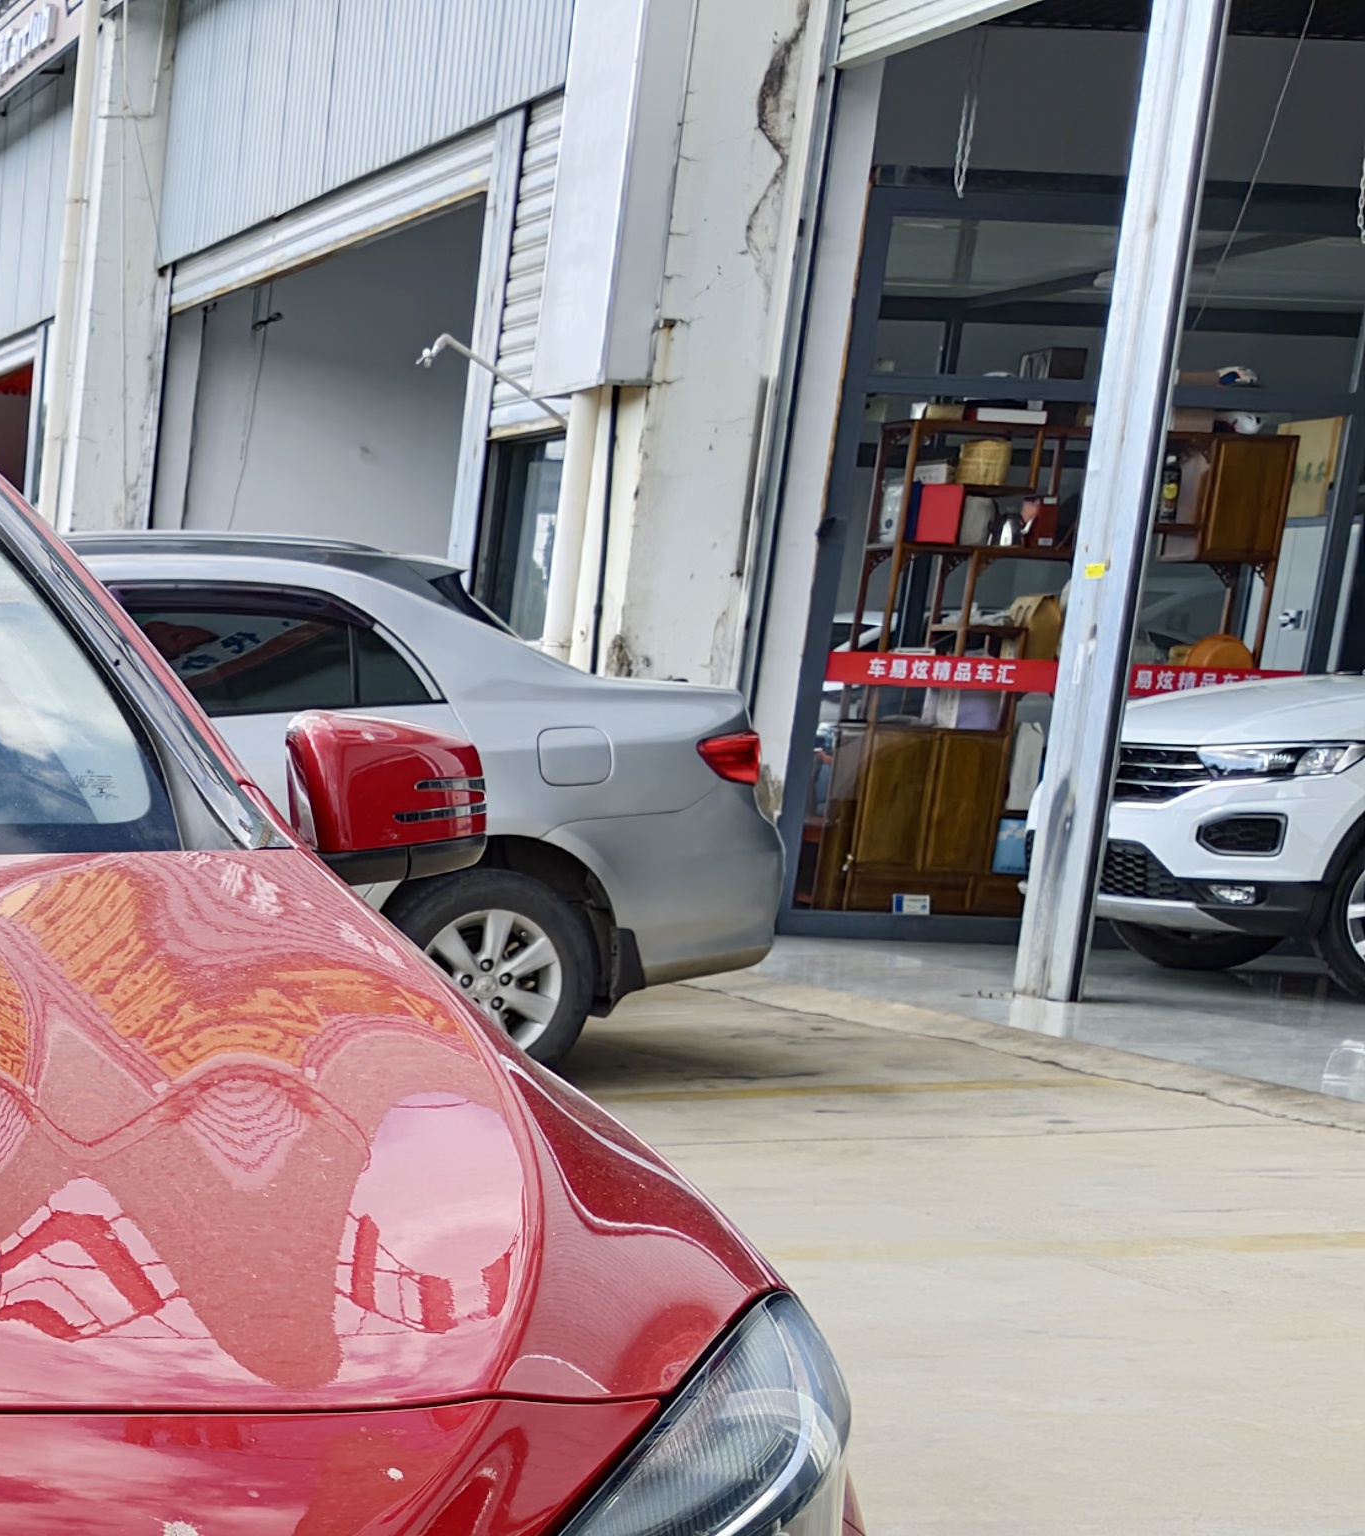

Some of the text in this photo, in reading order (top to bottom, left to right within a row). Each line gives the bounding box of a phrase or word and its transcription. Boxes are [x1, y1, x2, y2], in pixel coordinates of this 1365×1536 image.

[867, 658, 1017, 684] 车易炫精品车汇
